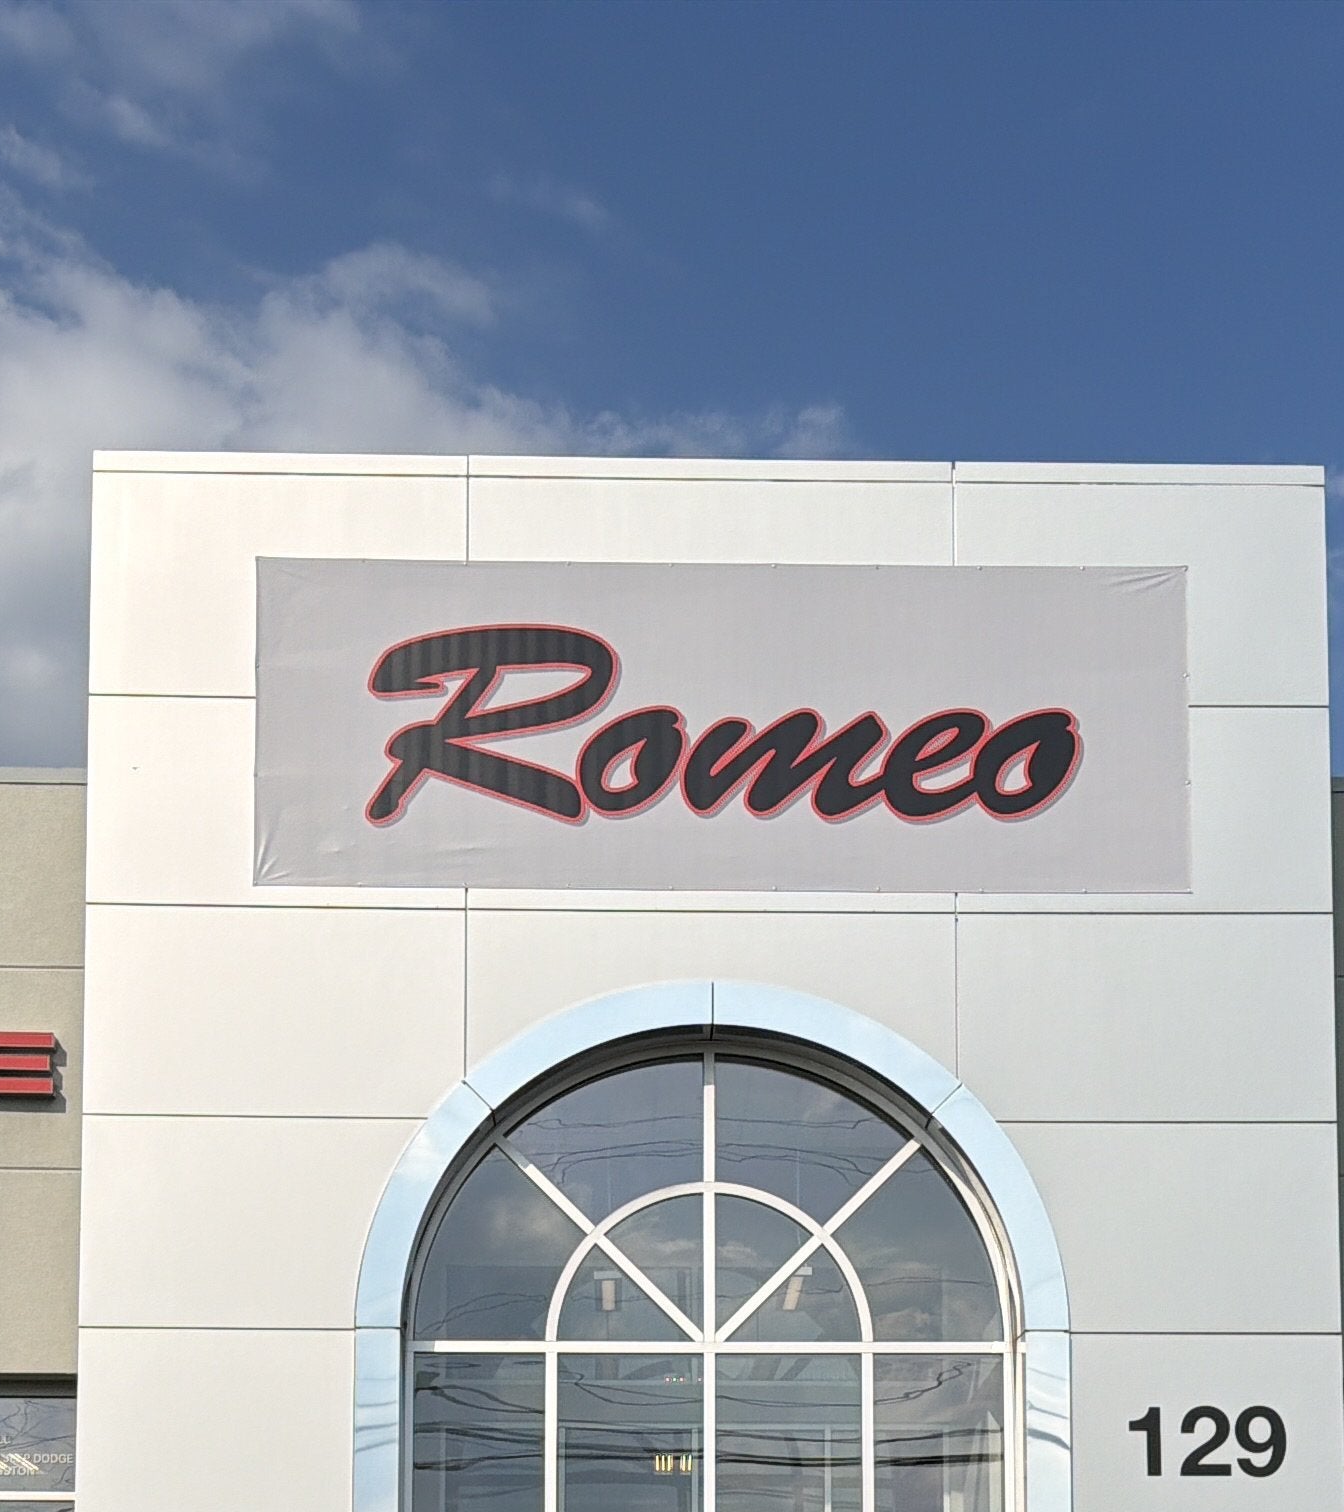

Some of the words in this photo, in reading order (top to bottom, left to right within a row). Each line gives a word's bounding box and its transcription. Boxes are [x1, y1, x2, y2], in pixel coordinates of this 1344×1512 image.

[365, 623, 1082, 826] Romeo
[34, 1453, 74, 1464] DODGE
[1128, 1405, 1287, 1478] 129
